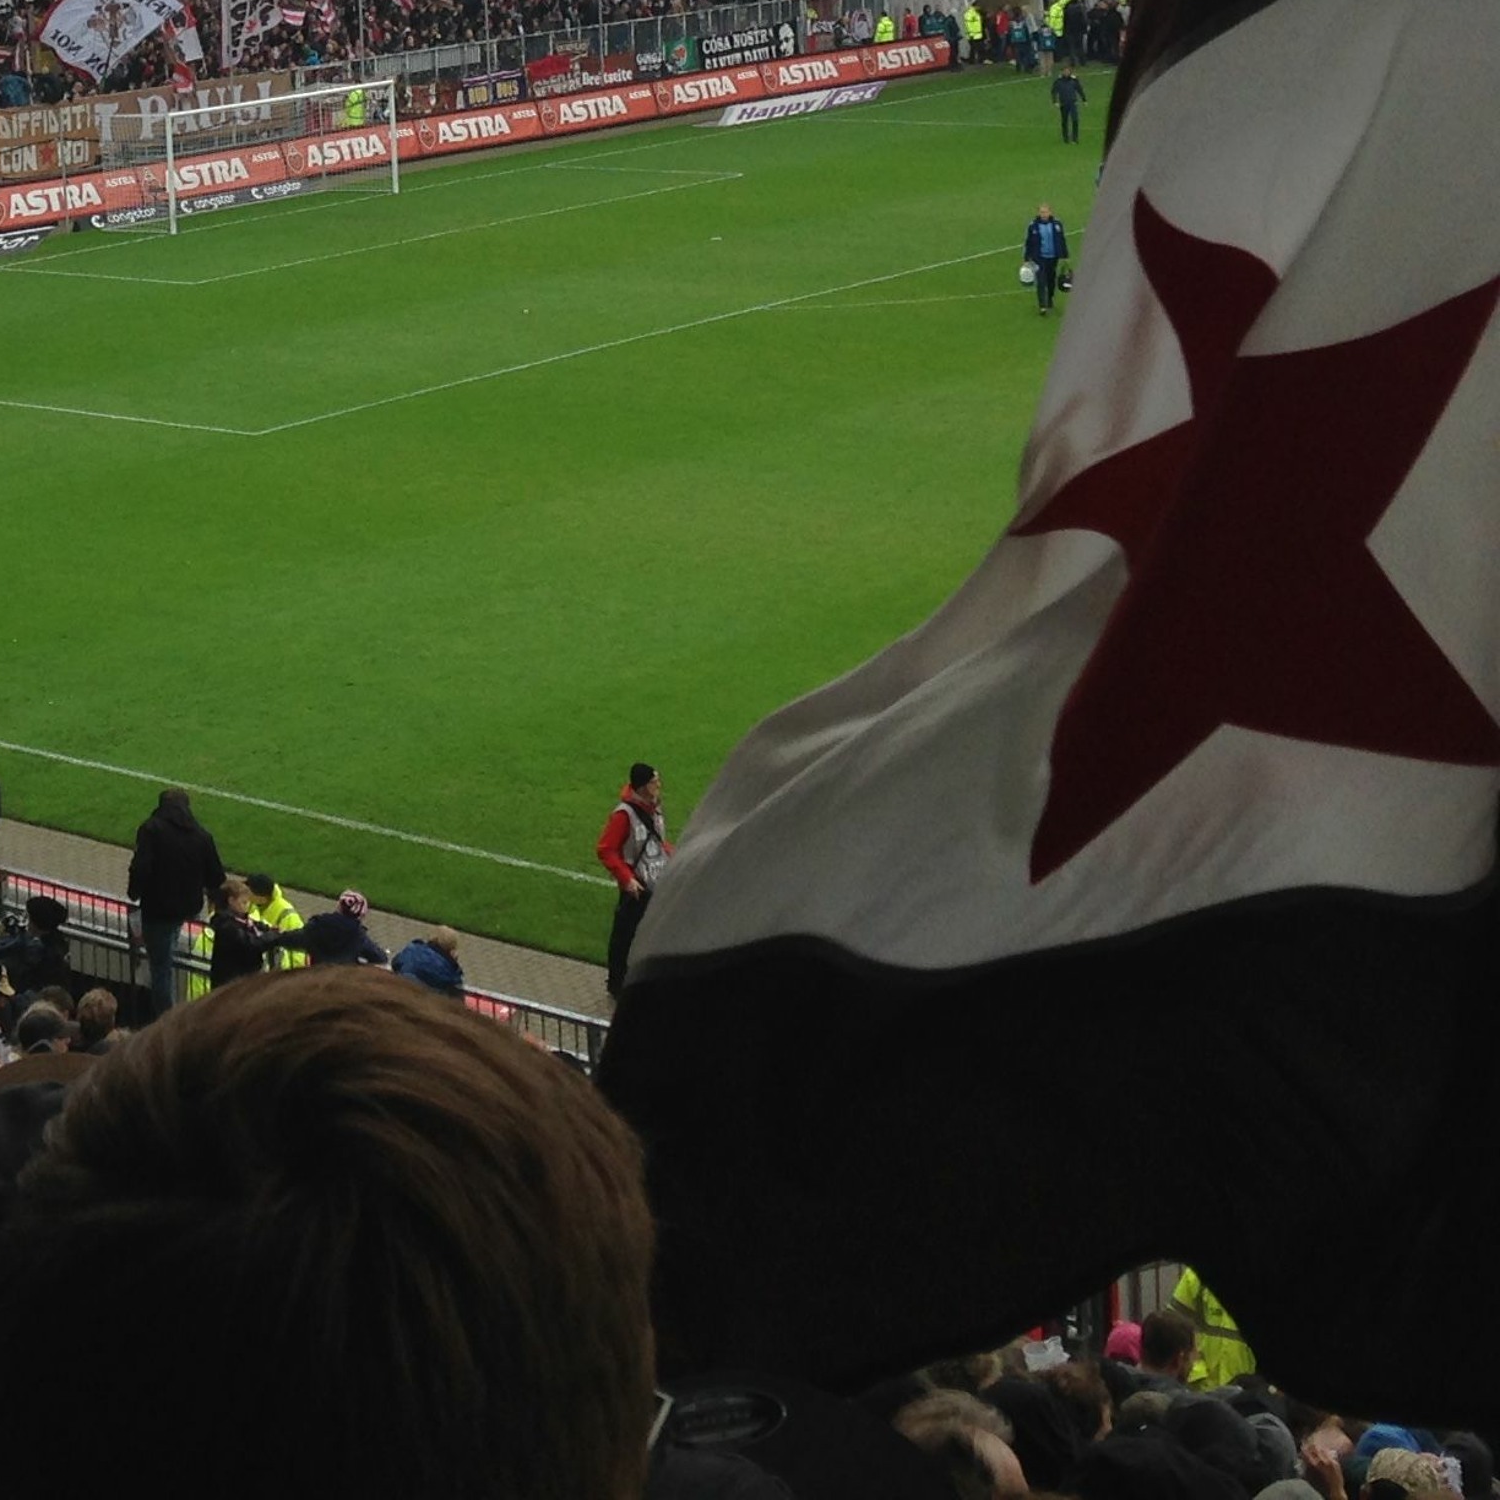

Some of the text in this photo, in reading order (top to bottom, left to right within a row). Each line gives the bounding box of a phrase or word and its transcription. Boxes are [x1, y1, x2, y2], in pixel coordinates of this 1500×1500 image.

[876, 44, 935, 71] ASTRA
[778, 59, 839, 86] ASTRA
[672, 75, 737, 105] ASTRA
[559, 95, 628, 124] ASTRA
[737, 96, 816, 121] Happy
[438, 114, 511, 143] ASTRA
[0, 144, 38, 173] CON
[307, 134, 386, 168] ASTRA
[9, 175, 136, 219] ASTRA ASTRA
